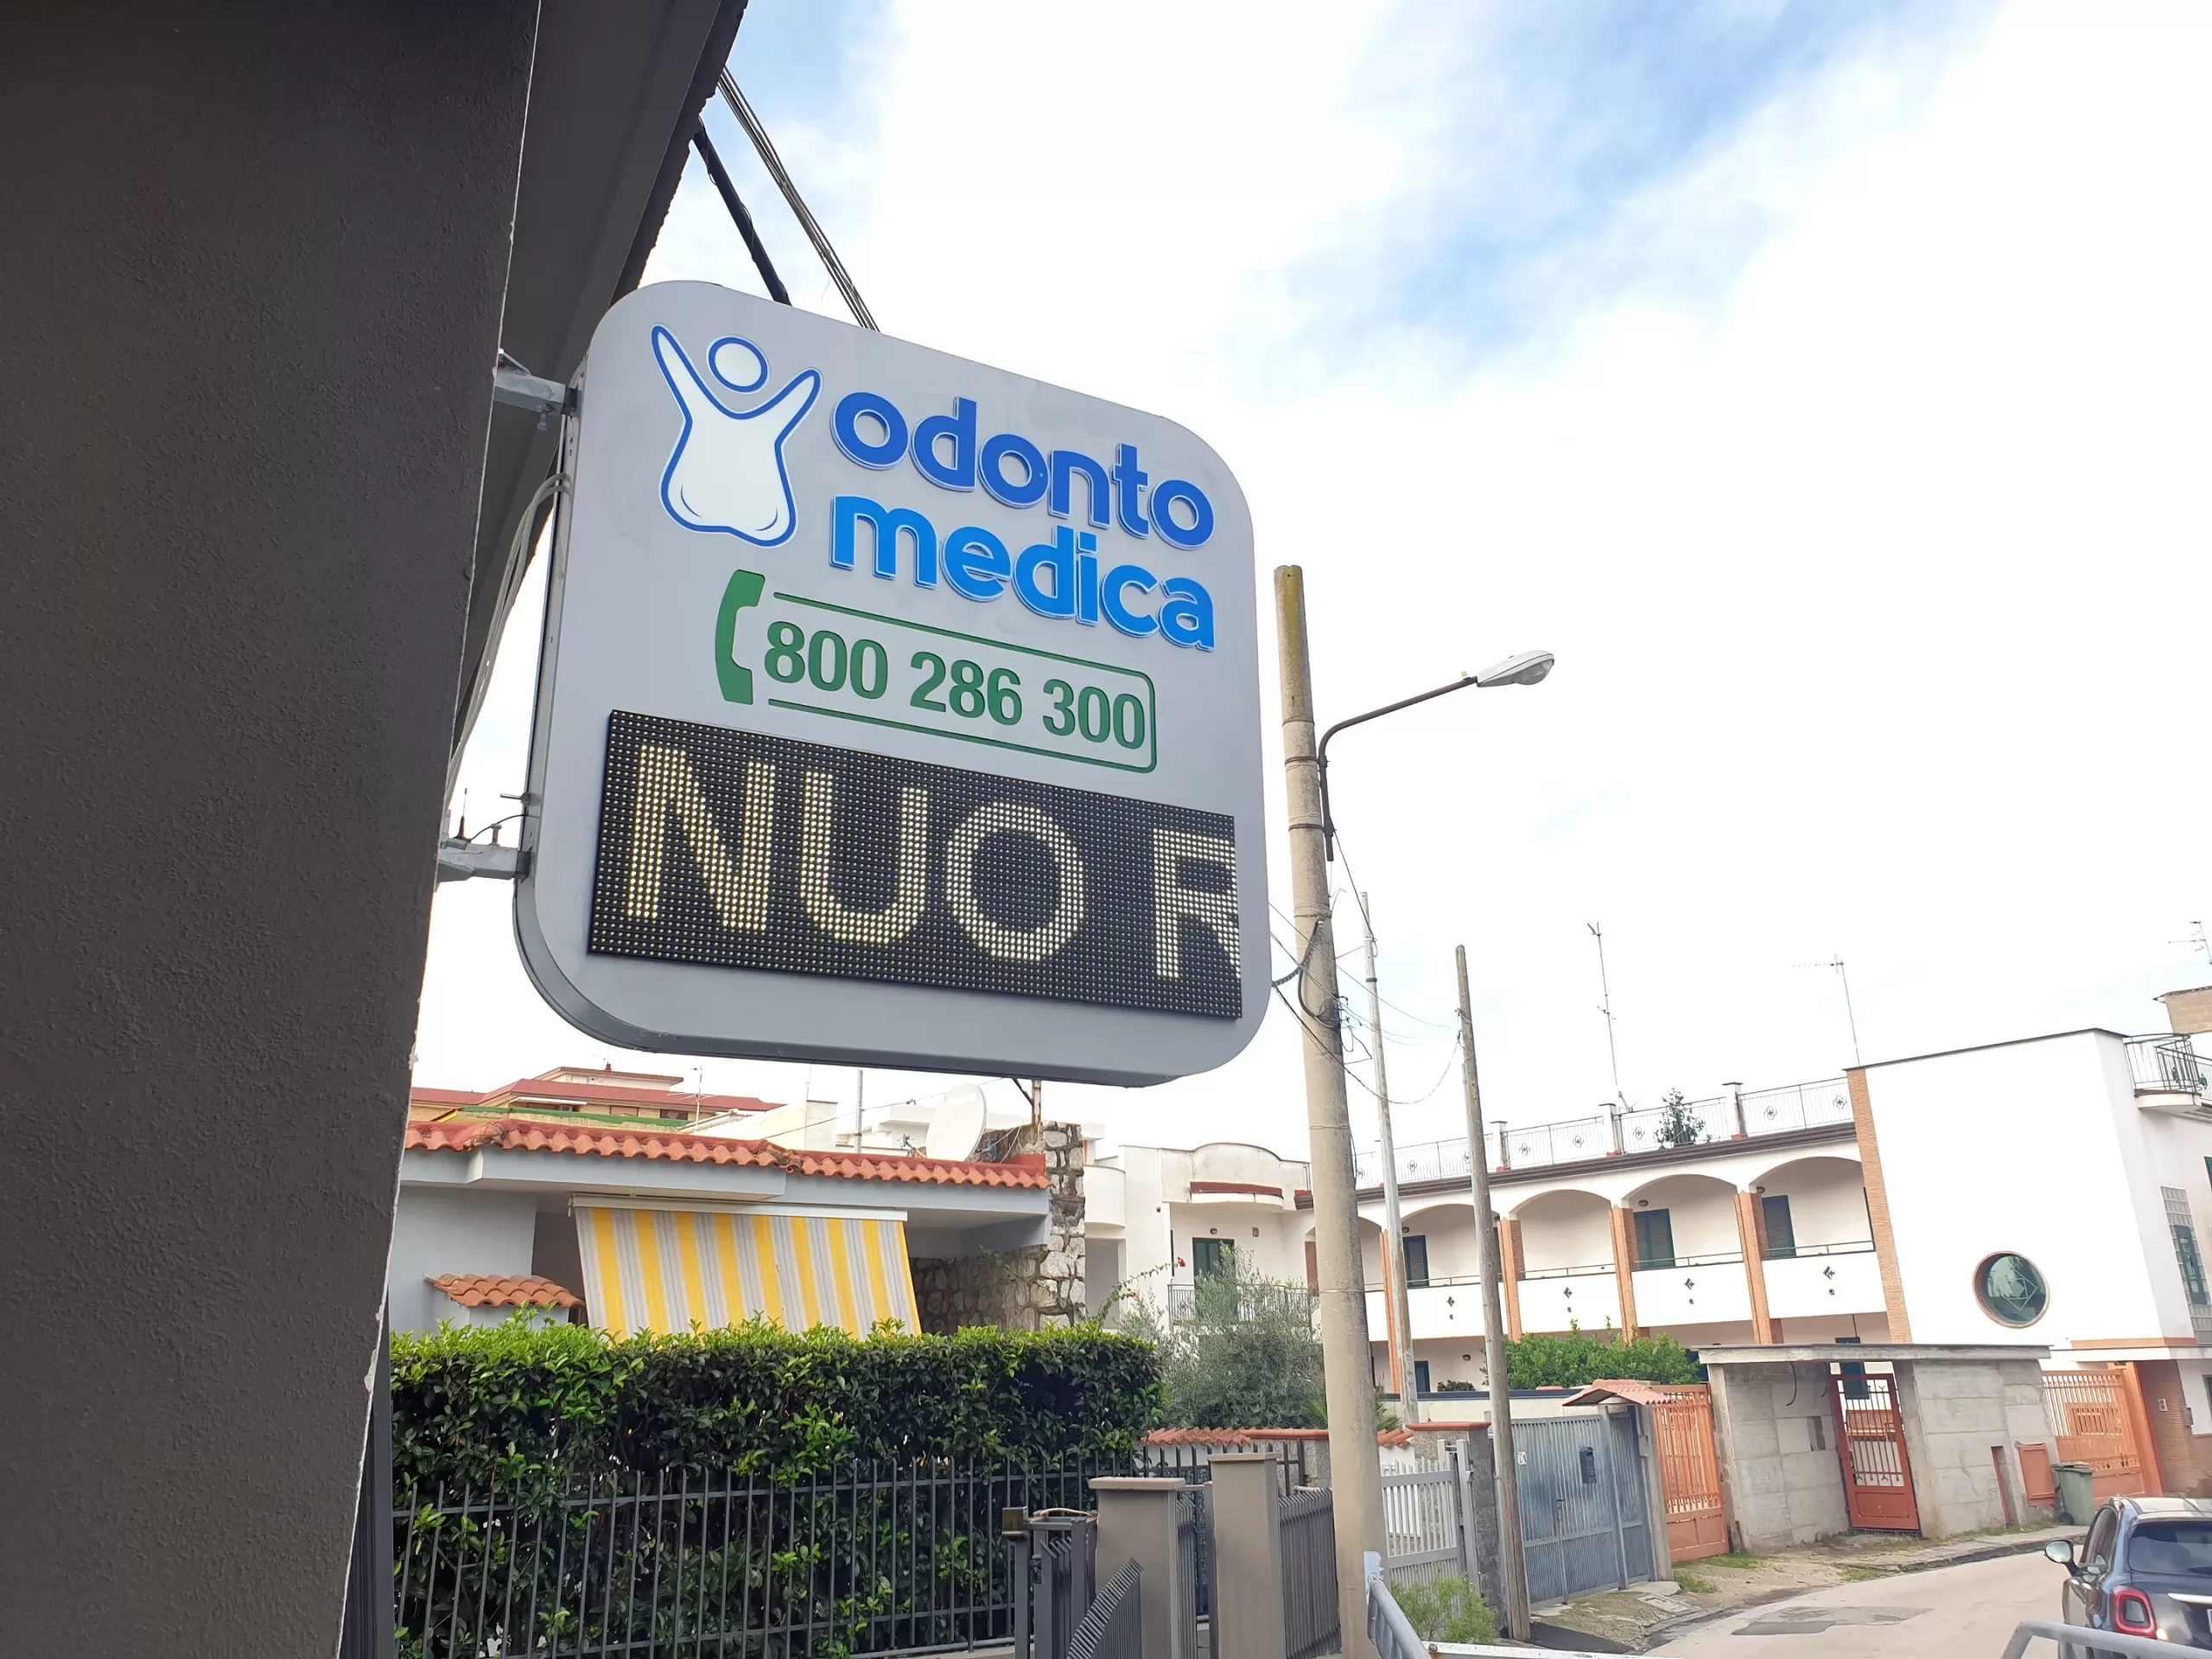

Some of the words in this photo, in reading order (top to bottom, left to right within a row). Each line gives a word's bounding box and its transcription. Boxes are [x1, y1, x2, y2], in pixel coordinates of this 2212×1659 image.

[830, 391, 1215, 550] odonto
[830, 495, 1215, 652] medica
[764, 621, 888, 700] 800
[910, 652, 1023, 727] 286
[1042, 678, 1146, 750] 300
[626, 743, 1087, 963] NUO
